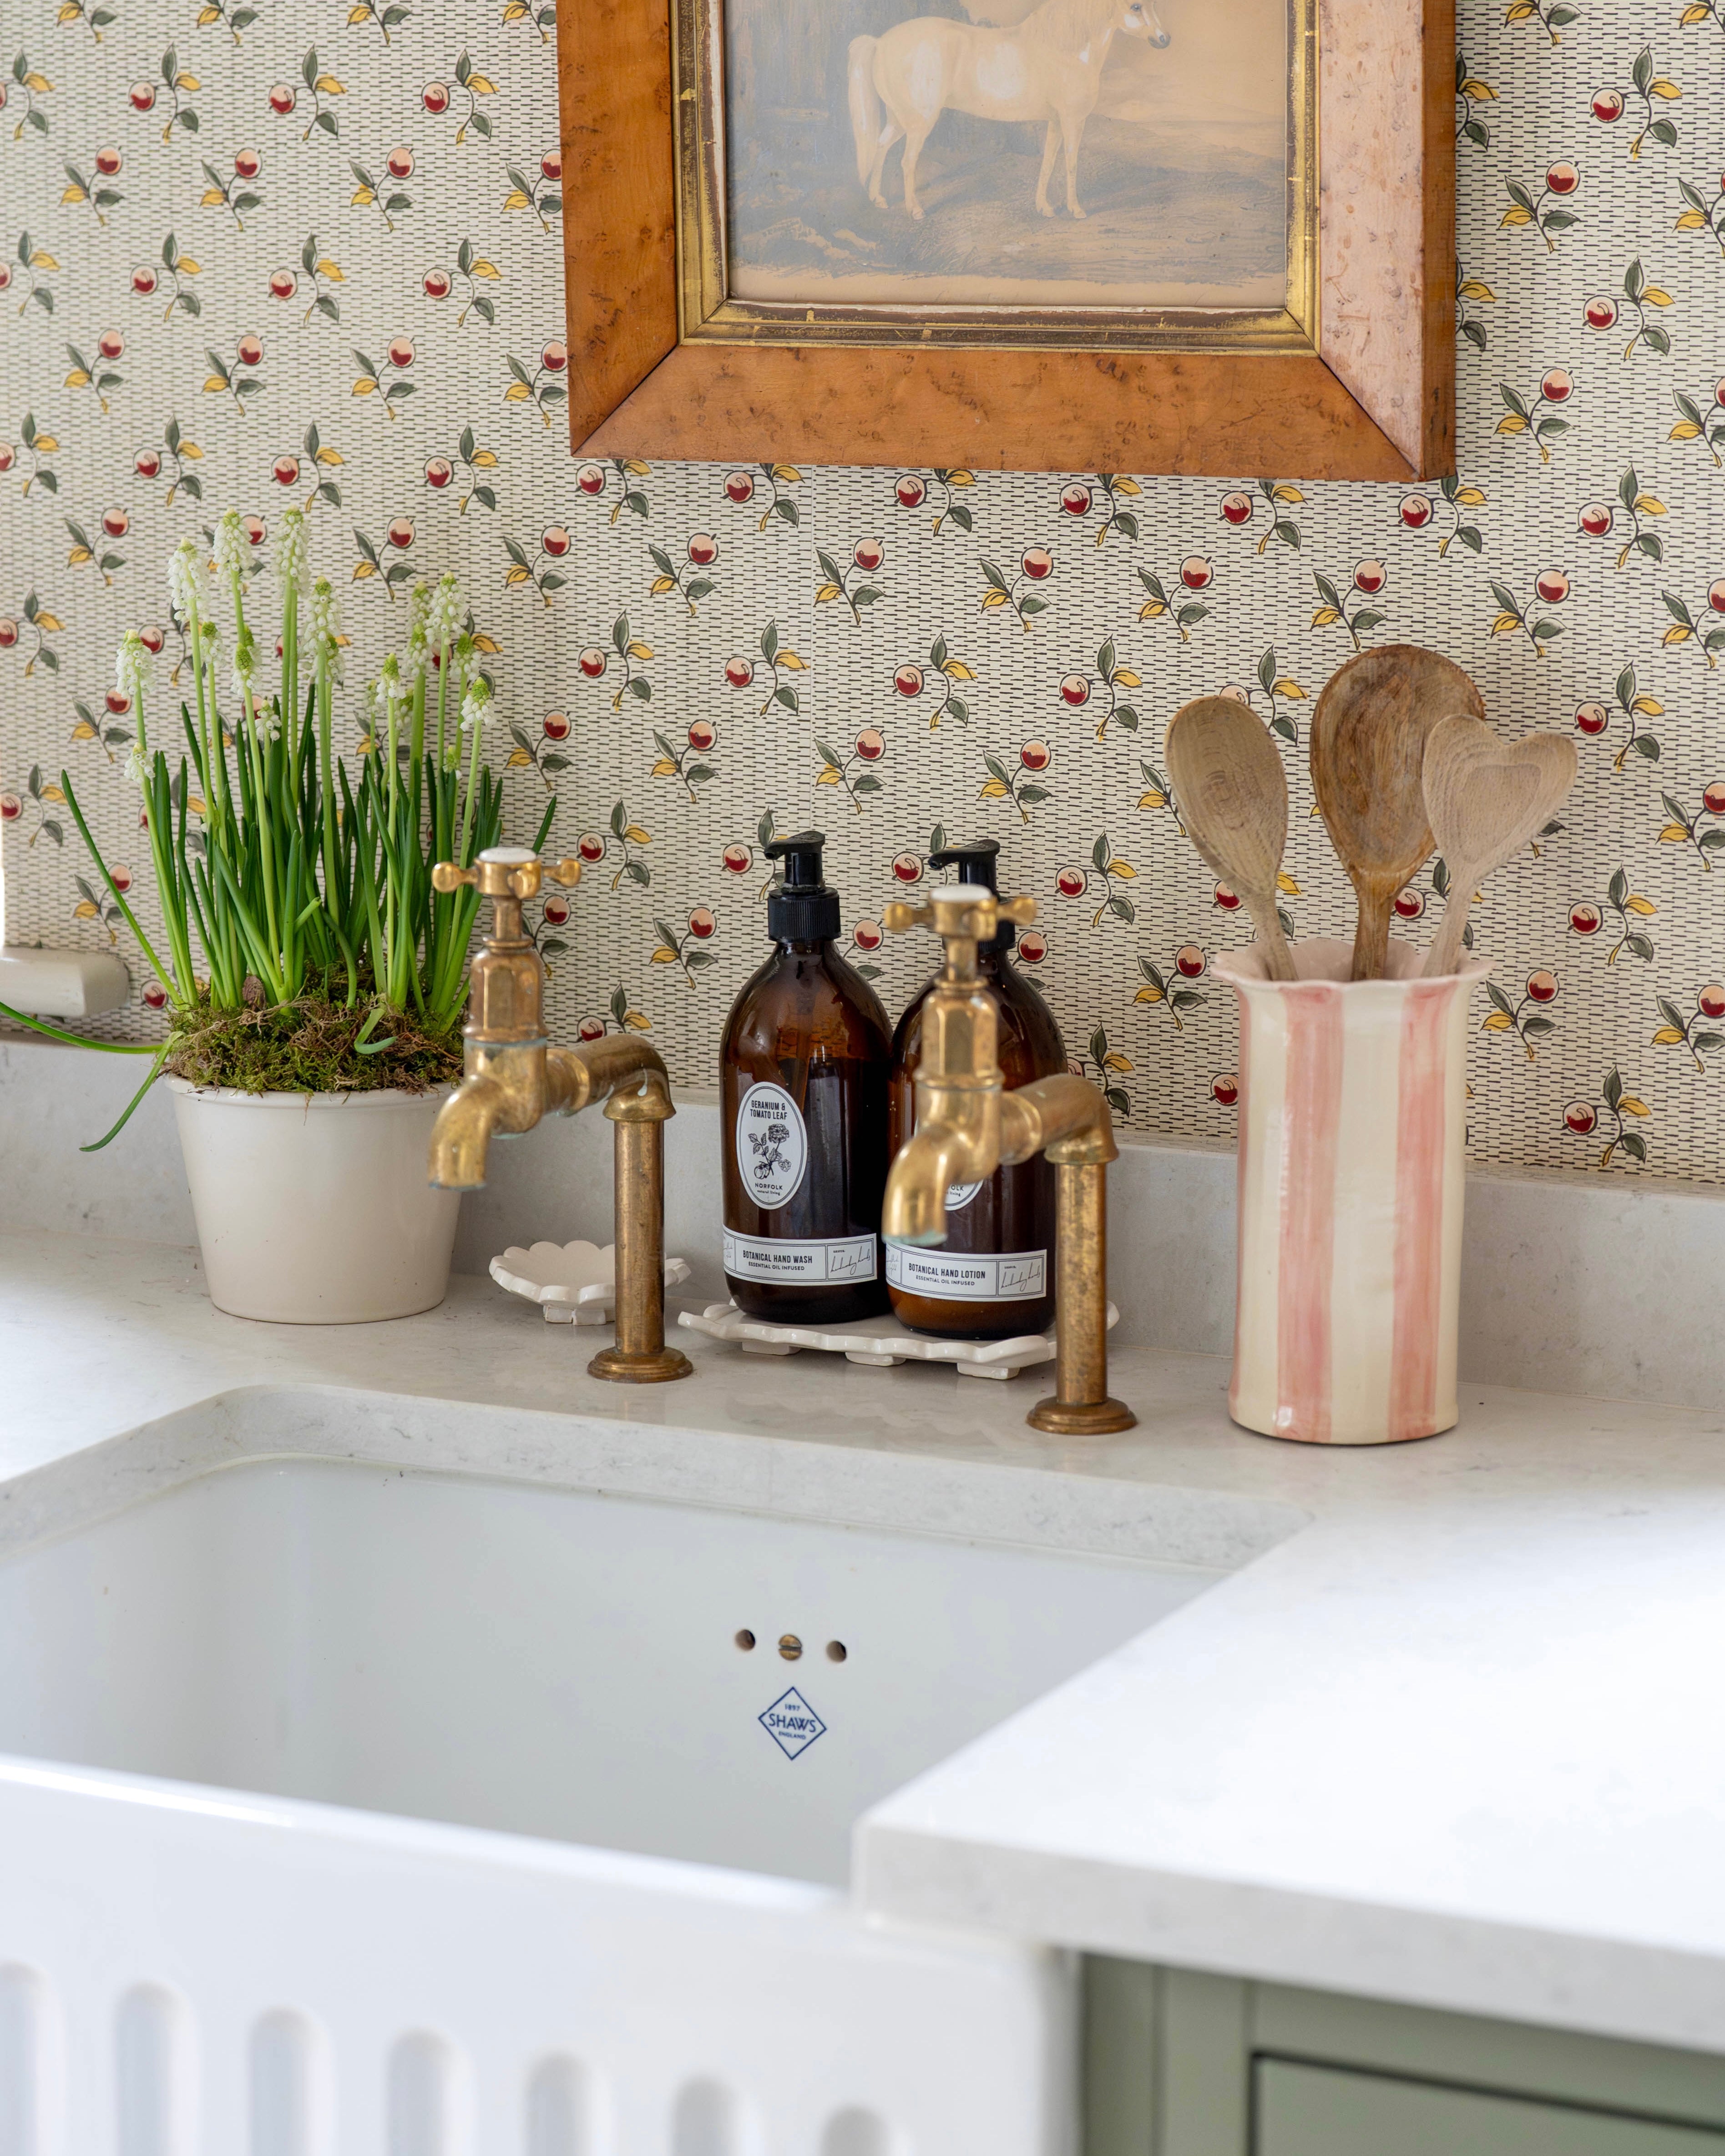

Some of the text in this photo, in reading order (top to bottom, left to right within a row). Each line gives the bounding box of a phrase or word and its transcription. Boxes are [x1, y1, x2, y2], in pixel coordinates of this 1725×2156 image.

[751, 1100, 779, 1110] GERANIUM
[750, 1109, 787, 1120] TOMATO LEAF
[743, 1250, 771, 1262] BOTANICAL
[774, 1254, 791, 1263] HAND
[909, 1263, 985, 1279] BOTANICAL HAND LOTION
[769, 1713, 816, 1732] SHAWS
[779, 1731, 806, 1740] ENGLAND
